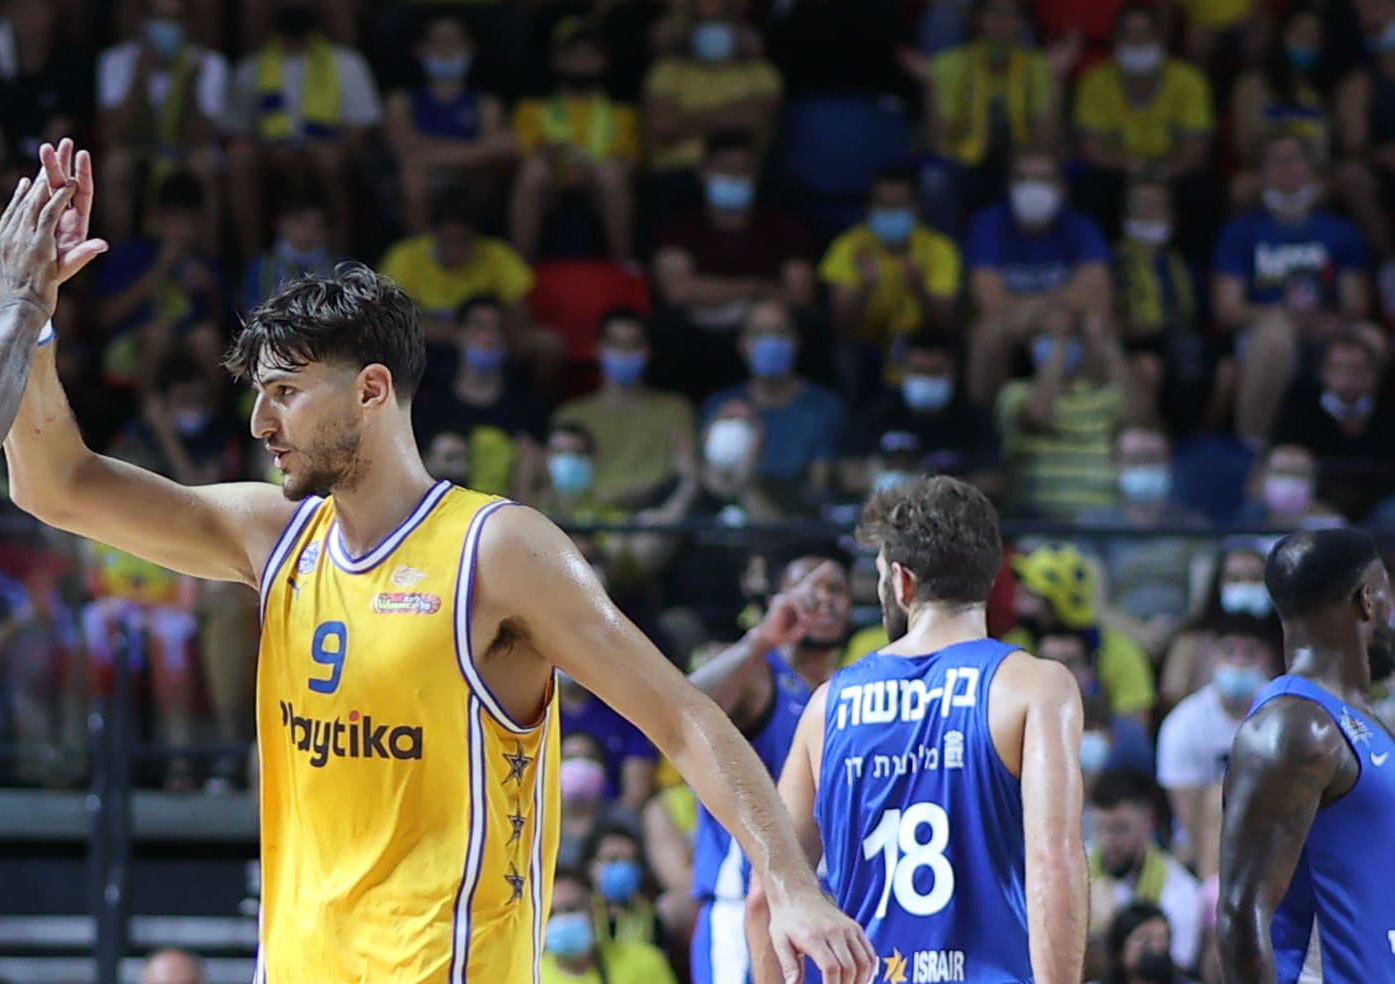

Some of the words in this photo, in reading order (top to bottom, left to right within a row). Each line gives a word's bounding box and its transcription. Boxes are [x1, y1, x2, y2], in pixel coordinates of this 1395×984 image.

[308, 620, 348, 694] 9
[837, 666, 980, 730] בן-משה
[862, 802, 955, 919] 18
[912, 950, 966, 984] ISRAIR
